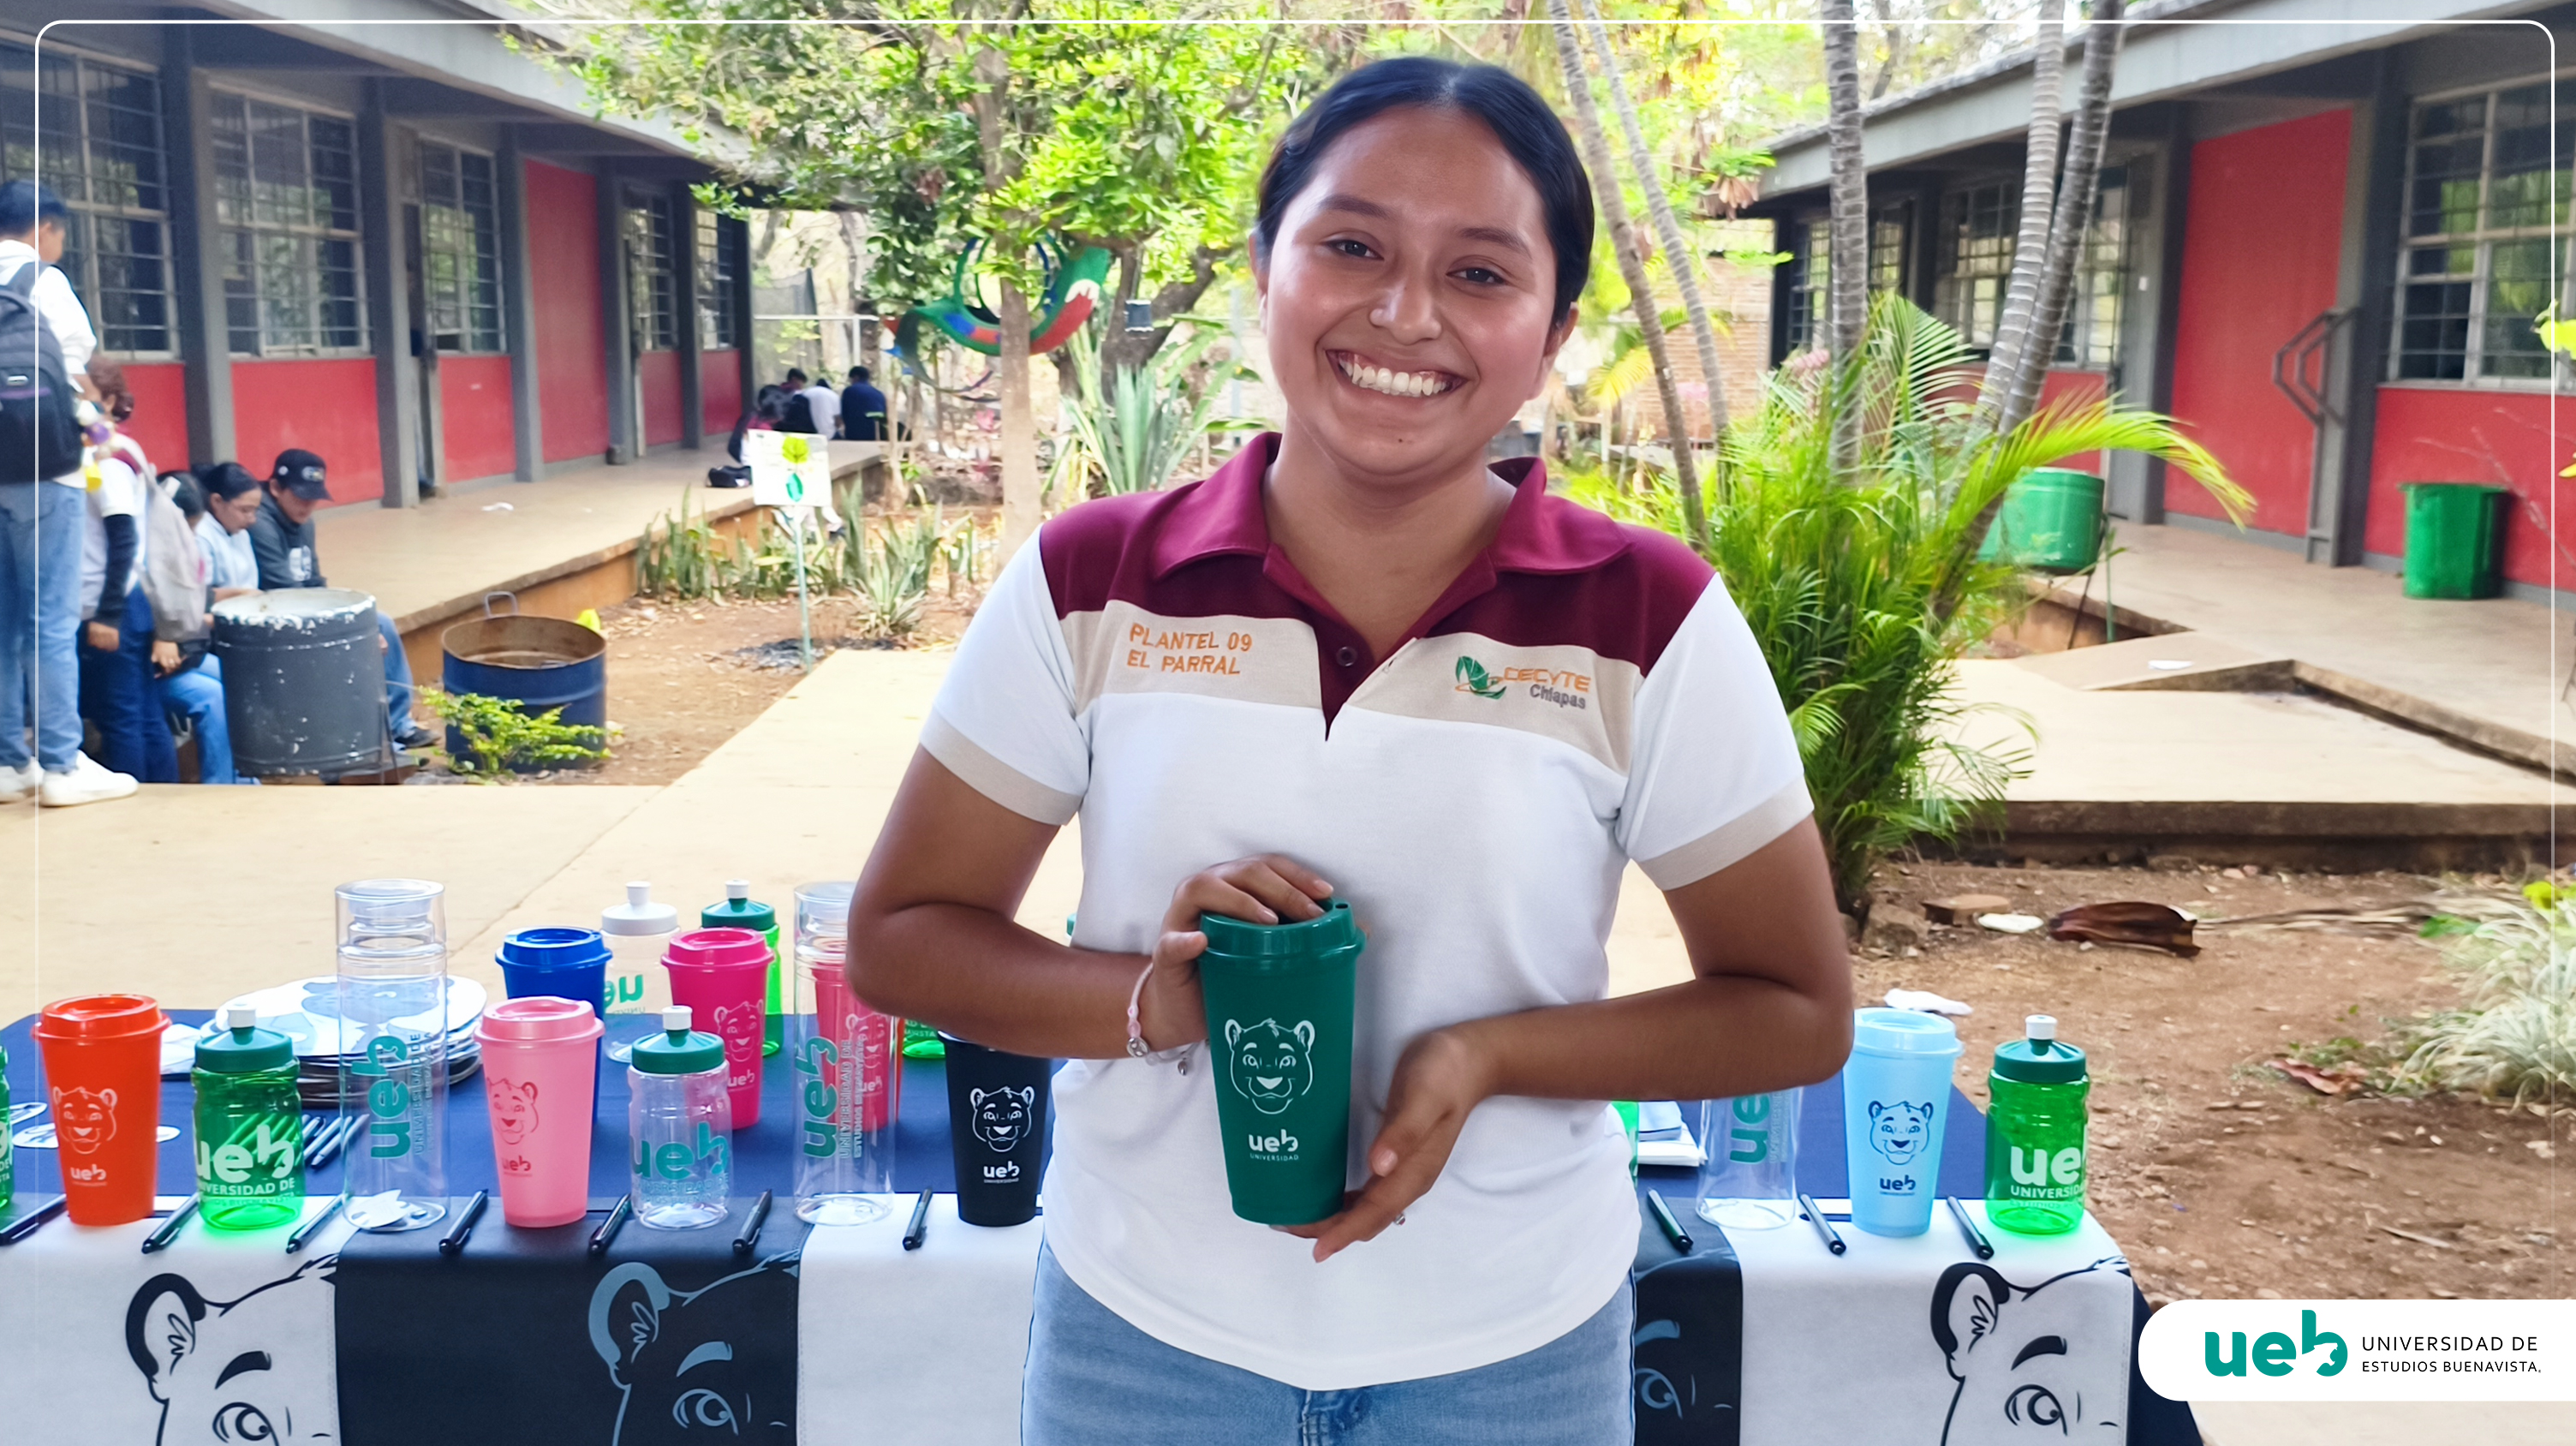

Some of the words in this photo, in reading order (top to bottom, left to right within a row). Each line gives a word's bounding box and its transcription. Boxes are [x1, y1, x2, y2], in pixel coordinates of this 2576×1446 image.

[1130, 622, 1219, 650] PLANTEL
[1227, 631, 1253, 652] 09
[1127, 648, 1150, 668] EL
[1161, 655, 1240, 675] PARRAL
[1504, 666, 1591, 692] CECYTE
[1530, 684, 1586, 709] Chiapas
[841, 1040, 852, 1059] DE
[727, 1069, 755, 1087] ueb
[350, 1036, 409, 1158] ueb
[795, 1037, 838, 1158] ueb
[839, 1061, 852, 1159] UNIVERSIDAD
[1249, 1128, 1298, 1153] ueb
[1730, 1094, 1770, 1163] ue
[983, 1161, 1020, 1178] ueb
[1249, 1153, 1299, 1162] UNIVERSIDAD
[70, 1163, 106, 1180] ueb
[1880, 1174, 1916, 1191] ueb
[279, 1177, 295, 1192] DE
